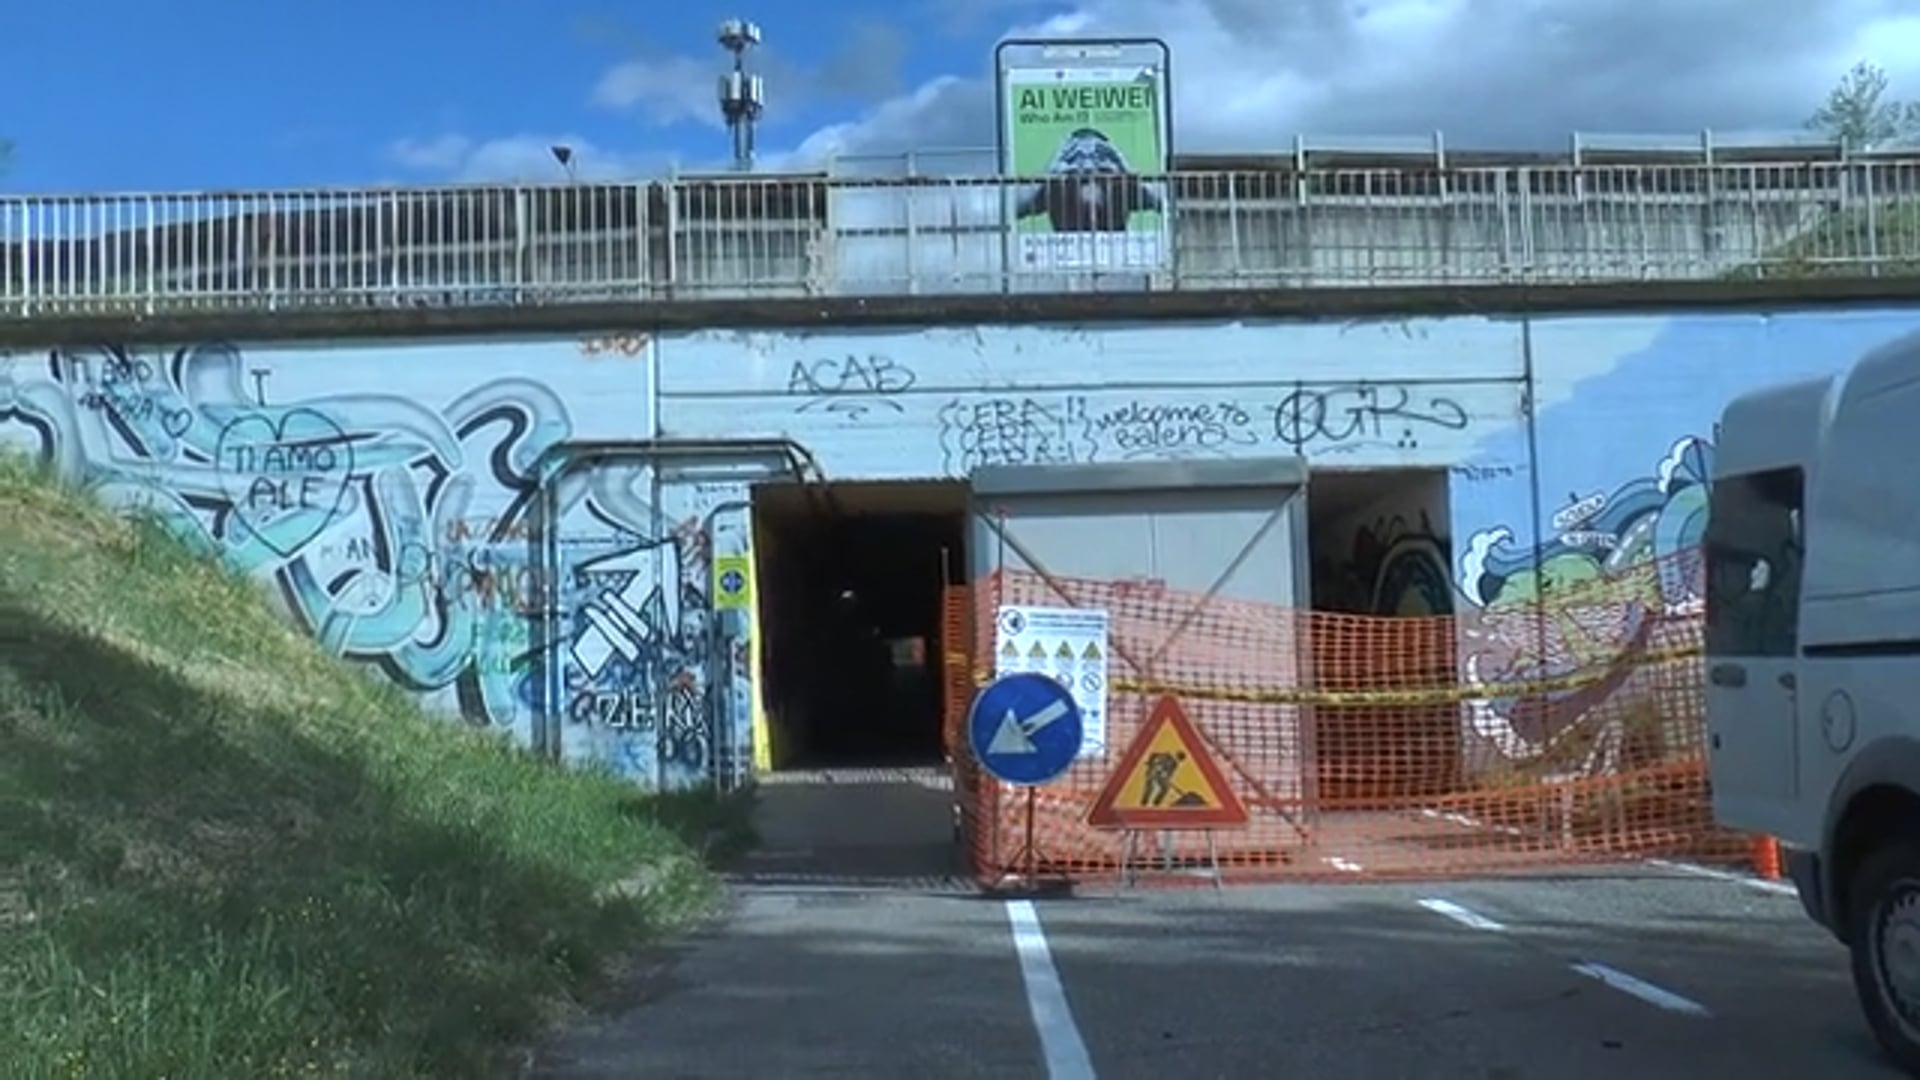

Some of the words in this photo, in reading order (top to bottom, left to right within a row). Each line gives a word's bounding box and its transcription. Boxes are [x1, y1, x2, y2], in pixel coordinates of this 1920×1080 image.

[1019, 87, 1044, 110] AI
[1052, 85, 1150, 109] WEIWEI
[787, 355, 917, 395] ACAB
[263, 443, 337, 473] AMO
[249, 476, 327, 510] ALE
